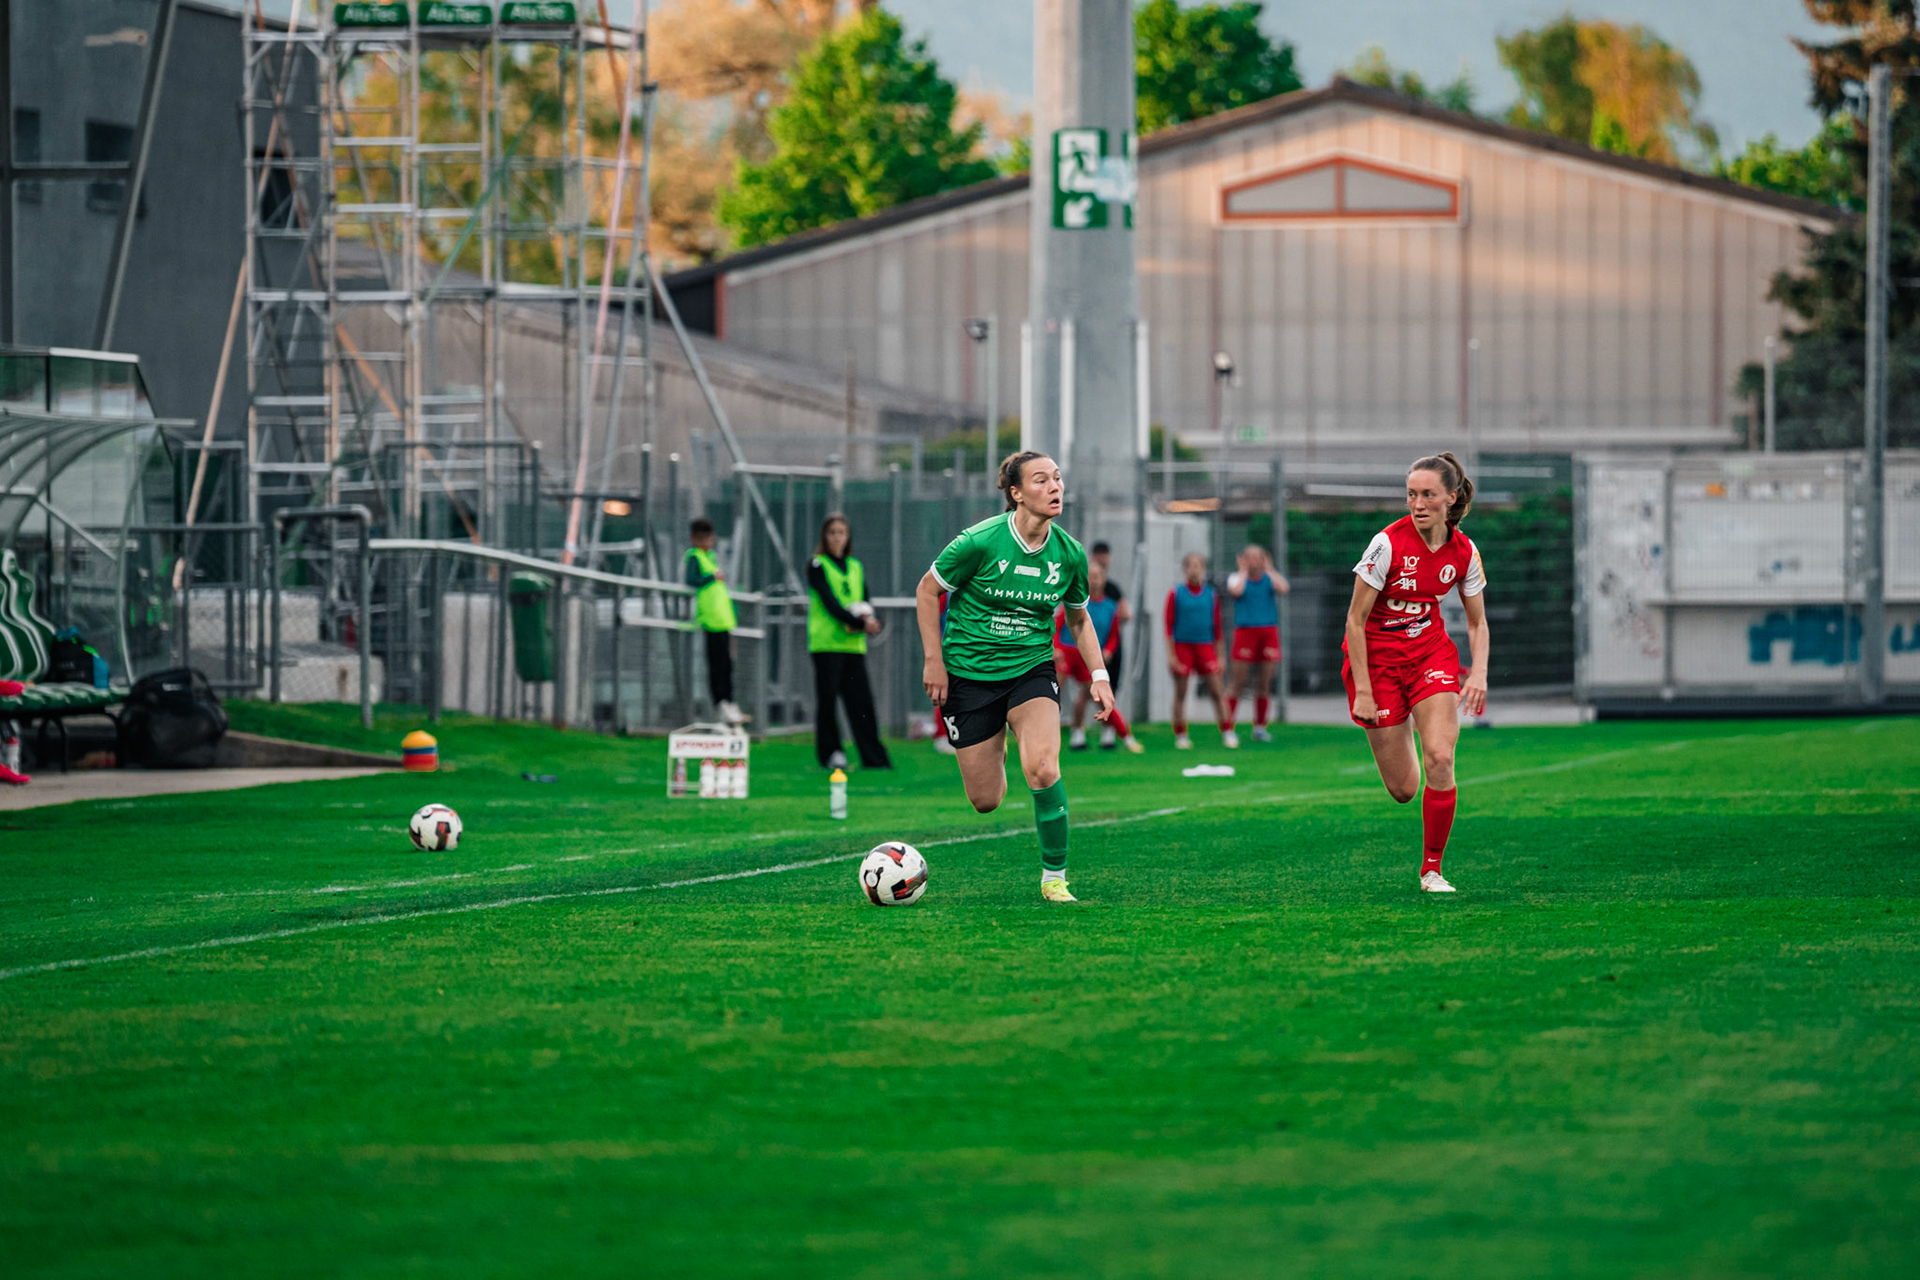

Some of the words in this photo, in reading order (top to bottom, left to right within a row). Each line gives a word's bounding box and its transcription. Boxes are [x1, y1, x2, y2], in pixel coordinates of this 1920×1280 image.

[343, 4, 398, 22] AluTec
[426, 4, 482, 23] AluTec
[510, 3, 566, 21] AluTec
[1391, 577, 1417, 591] AXA
